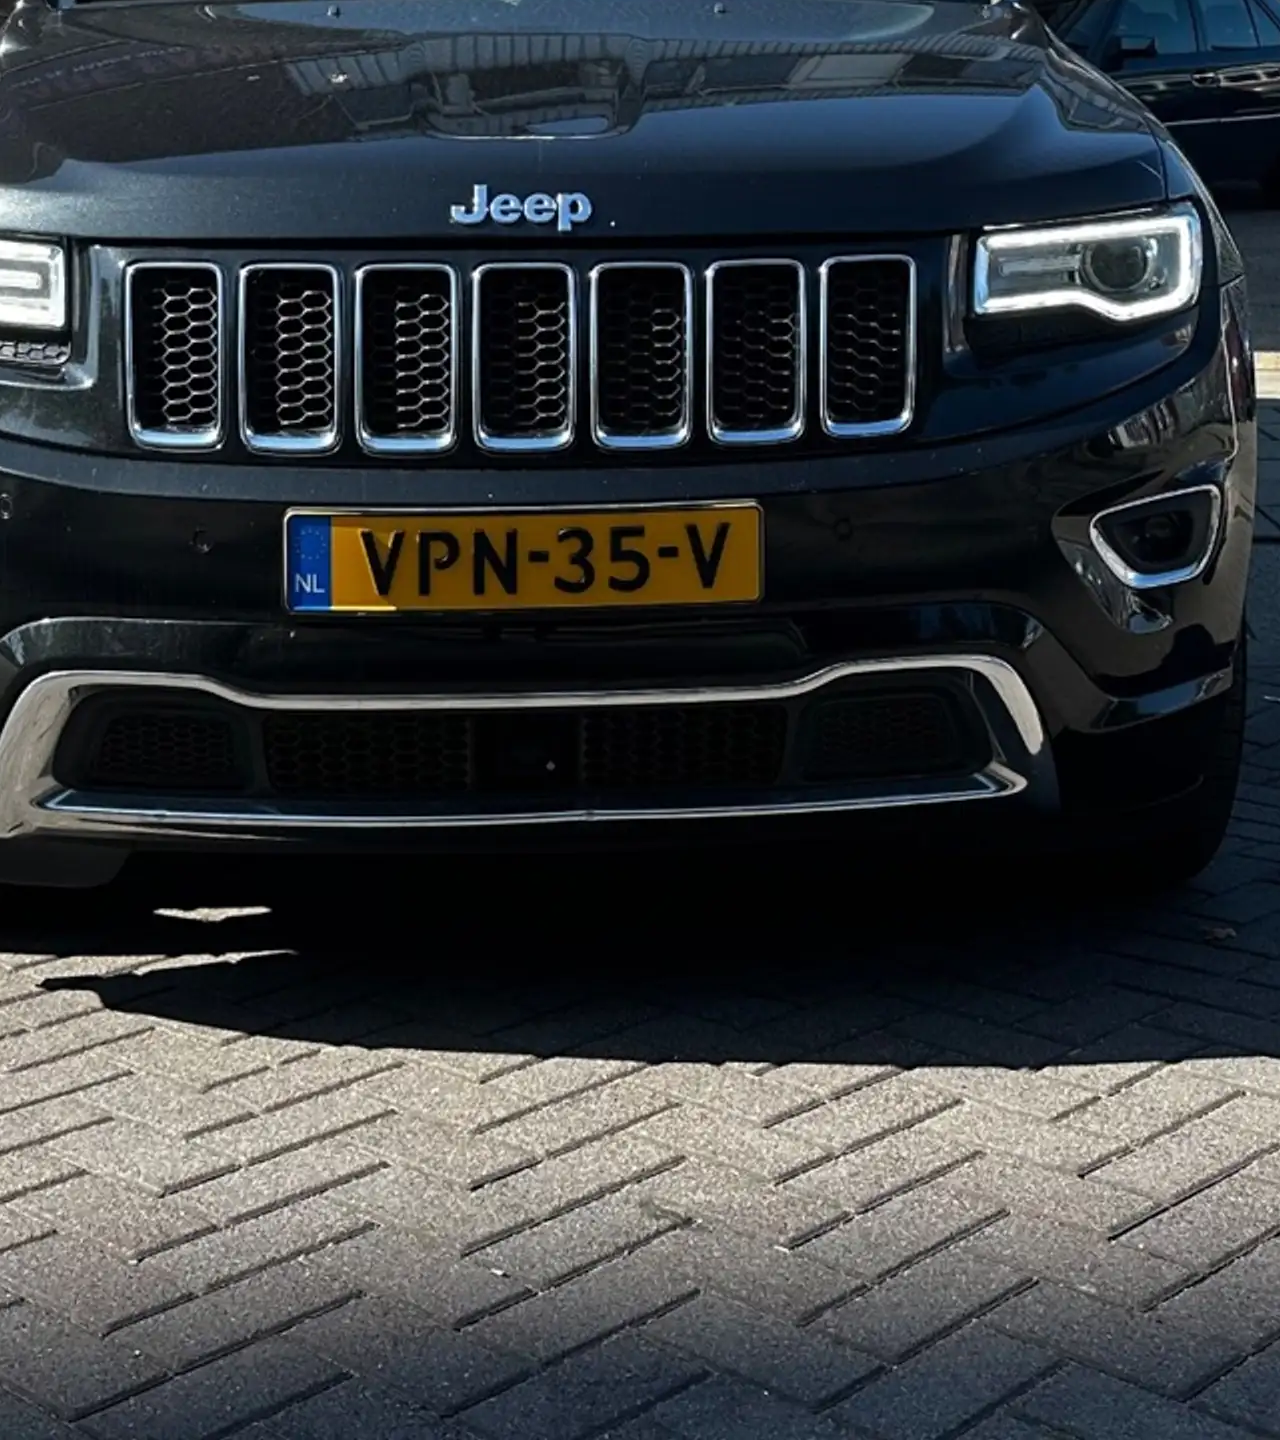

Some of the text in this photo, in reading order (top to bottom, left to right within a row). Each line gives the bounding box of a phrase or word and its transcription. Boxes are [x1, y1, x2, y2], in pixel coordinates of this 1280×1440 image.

[450, 184, 592, 231] Jeep
[295, 522, 731, 597] NL VPN-35-V
